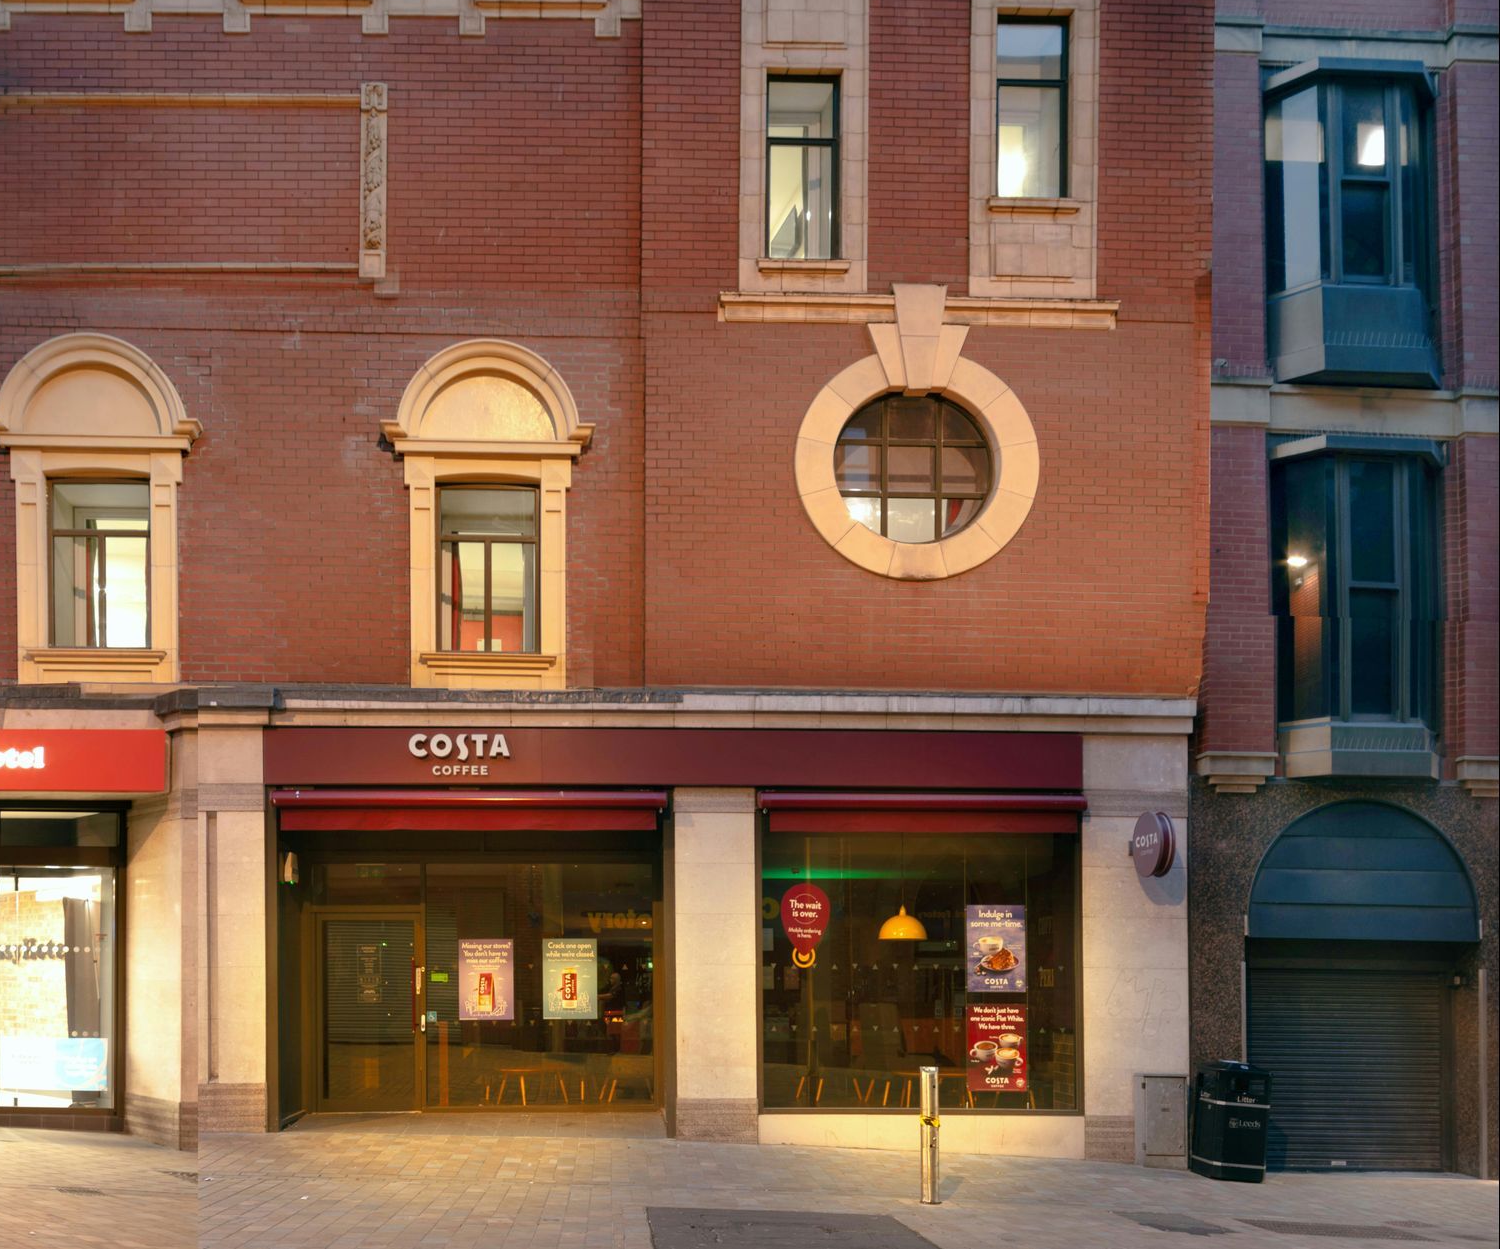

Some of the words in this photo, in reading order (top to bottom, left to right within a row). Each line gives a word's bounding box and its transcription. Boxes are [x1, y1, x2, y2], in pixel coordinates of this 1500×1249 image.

[408, 733, 511, 761] COSTA
[432, 765, 489, 776] COFFEE
[1135, 832, 1158, 848] COSTA
[789, 899, 804, 909] The
[806, 901, 822, 910] wait
[792, 908, 798, 917] is
[979, 909, 1004, 921] Indulge
[1005, 910, 1013, 918] in
[462, 942, 482, 951] Missing
[985, 1077, 1010, 1085] COSTA
[1239, 1119, 1261, 1128] Leeds
